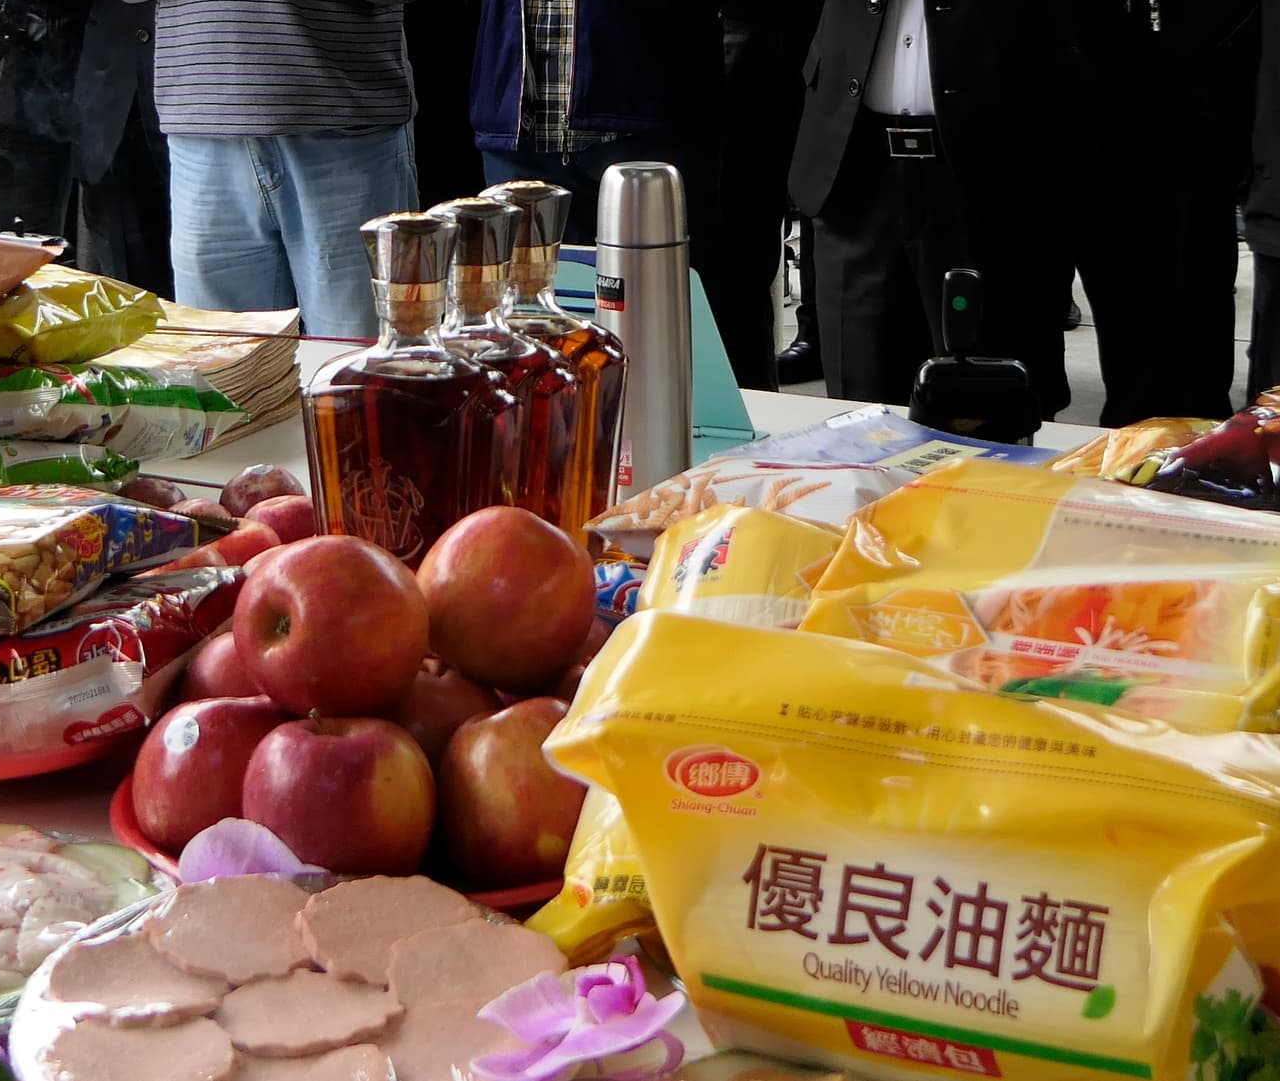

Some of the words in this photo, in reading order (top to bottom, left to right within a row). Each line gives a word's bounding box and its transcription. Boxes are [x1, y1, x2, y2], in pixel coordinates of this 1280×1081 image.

[671, 798, 757, 817] Shiang-Chuan
[742, 842, 1110, 993] 優良油麵
[802, 951, 872, 994] Quality
[875, 964, 940, 1002] Yellow
[943, 980, 1019, 1019] Noodle
[861, 1025, 986, 1073] 經濟包
